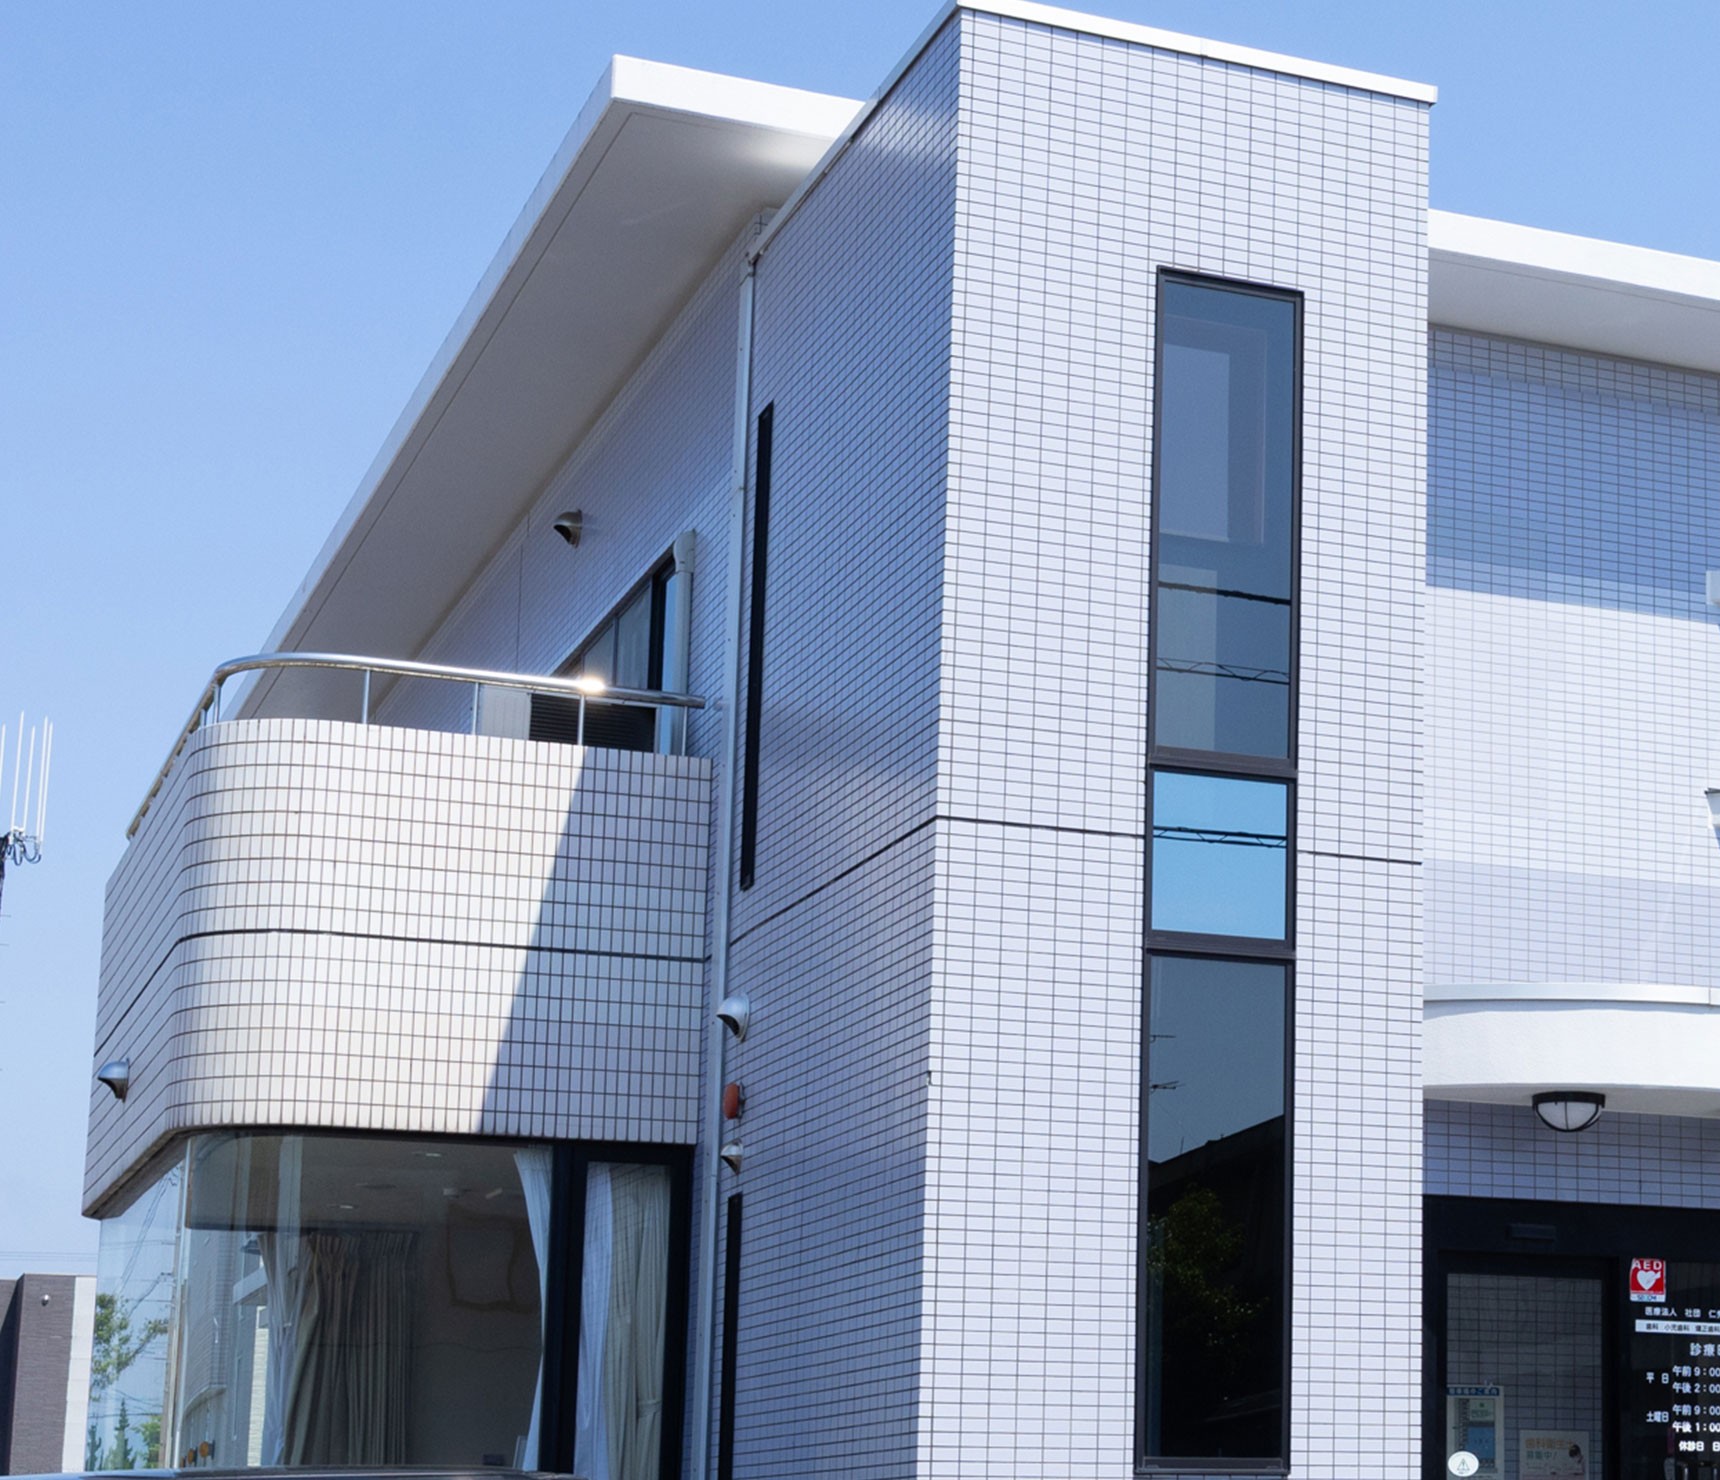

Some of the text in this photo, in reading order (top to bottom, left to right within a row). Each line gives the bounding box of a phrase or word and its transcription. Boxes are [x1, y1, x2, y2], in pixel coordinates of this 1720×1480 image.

[1631, 1259, 1663, 1270] AED
[1646, 1411, 1670, 1423] 土曜日
[1678, 1440, 1705, 1452] 休診日
